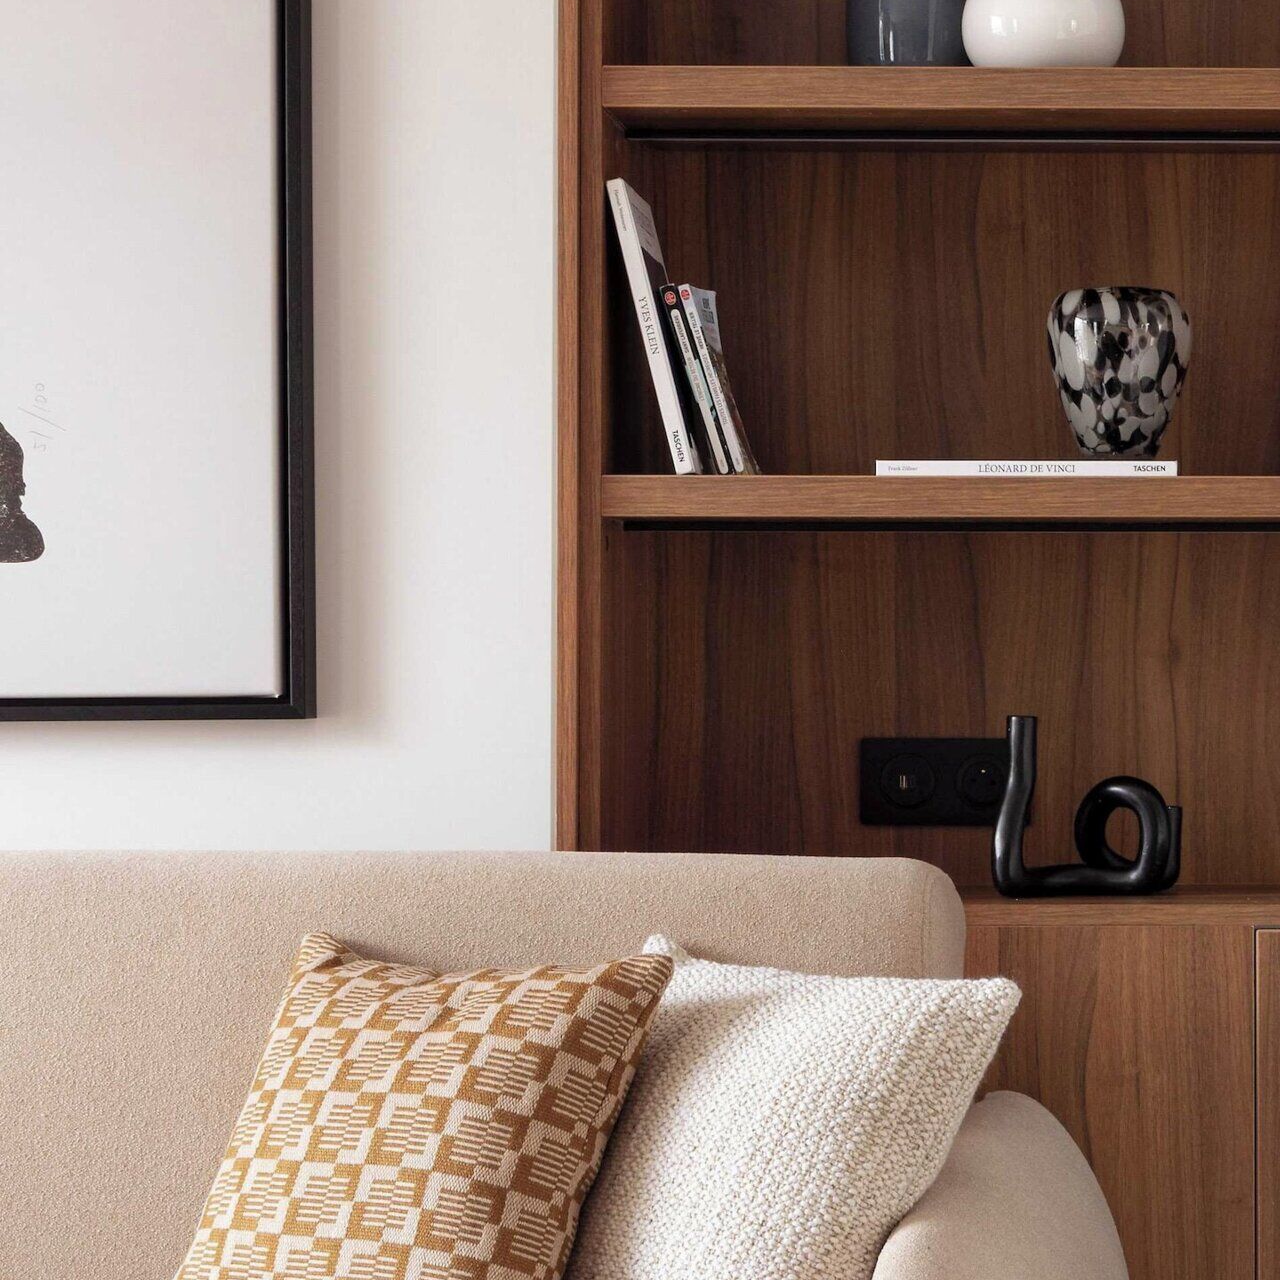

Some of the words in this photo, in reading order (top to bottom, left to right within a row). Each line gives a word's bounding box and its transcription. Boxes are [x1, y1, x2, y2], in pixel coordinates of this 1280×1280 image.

[638, 296, 652, 323] YVES
[644, 323, 660, 355] KLEIN
[671, 429, 686, 463] TASCHEN
[978, 463, 1029, 473] LÉONARD
[1030, 464, 1044, 473] DE
[1046, 464, 1076, 473] VINCI
